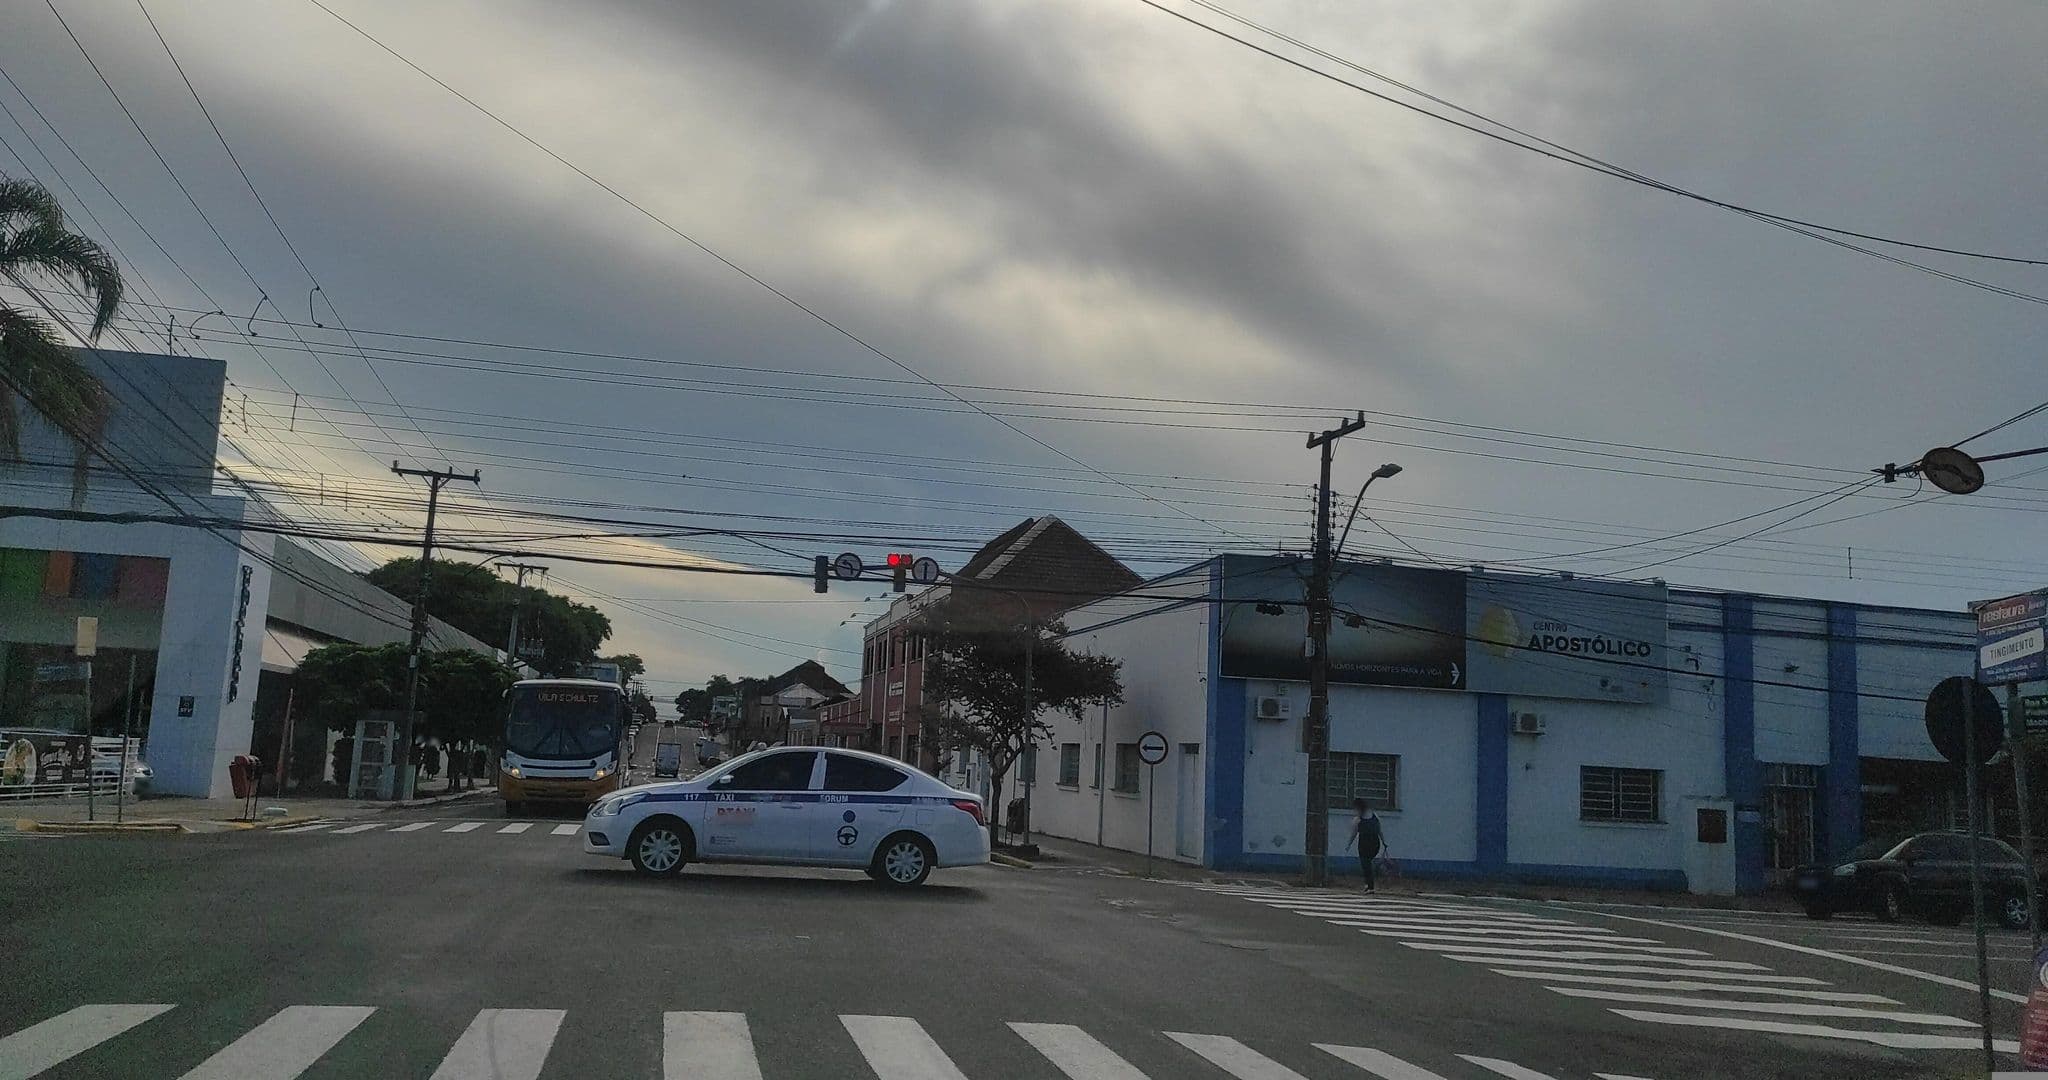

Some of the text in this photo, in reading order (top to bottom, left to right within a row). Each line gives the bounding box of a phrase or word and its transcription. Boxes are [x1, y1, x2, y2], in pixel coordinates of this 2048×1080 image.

[1533, 621, 1568, 633] CENTRO
[1528, 634, 1651, 657] APOSTÓLICO
[1990, 637, 2034, 659] TINGIMENTO
[1355, 663, 1400, 673] HORIZONTES
[714, 793, 735, 801] TAXI
[820, 794, 849, 803] FORUM
